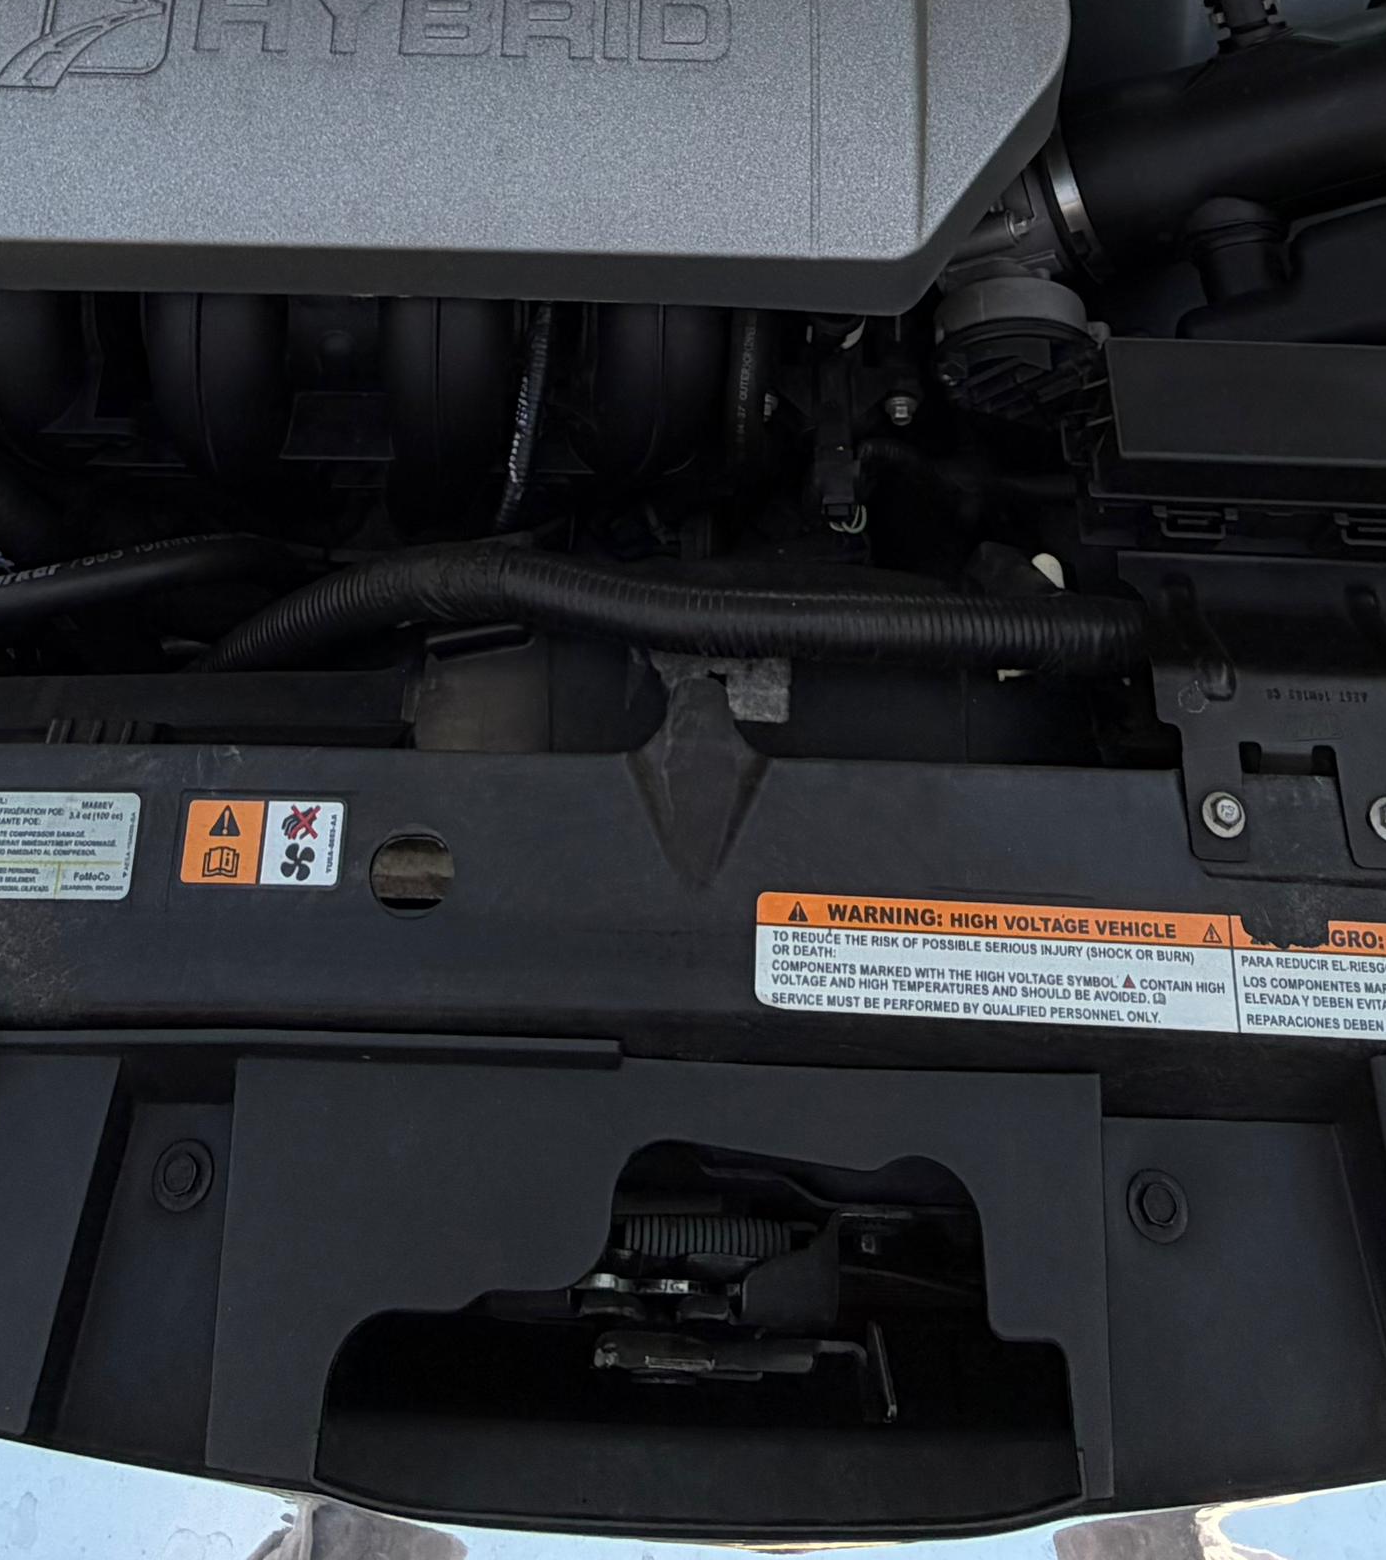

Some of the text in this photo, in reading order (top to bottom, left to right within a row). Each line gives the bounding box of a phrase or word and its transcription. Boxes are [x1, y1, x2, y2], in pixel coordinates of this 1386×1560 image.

[827, 903, 1177, 939] WARNING: HIGH VOLTAGE VEHICLE
[772, 944, 837, 959] OR DEATH:
[773, 930, 1195, 963] TO REDUCE THE RISK OF POSSIBLE SERIOUS INJURY (SHOCK OR BURN)
[1241, 954, 1273, 968] PARA
[1275, 956, 1329, 971] REDUCIR
[1331, 959, 1347, 972] EL
[771, 973, 1151, 1004] VOLTAGE AND HIGH TEMPERATURES AND SHOULD BE AVOIDED.
[772, 959, 1226, 994] COMPONENTS MARKED WITH THE HIGH VOLTAGE SYMBOL CONTAIN HIGH
[1243, 975, 1267, 989] LOS
[1269, 976, 1361, 994] COMPONENTES
[771, 992, 1162, 1024] SERVICE MUST BE PERFORMED BY QUALIFIED PERSONNEL ONLY.
[1244, 992, 1300, 1007] ELEVADA
[1302, 995, 1310, 1008] Y
[1312, 996, 1354, 1010] DEBEN
[1247, 1013, 1340, 1030] REPARACIONES
[1343, 1018, 1384, 1032] DEBEN
